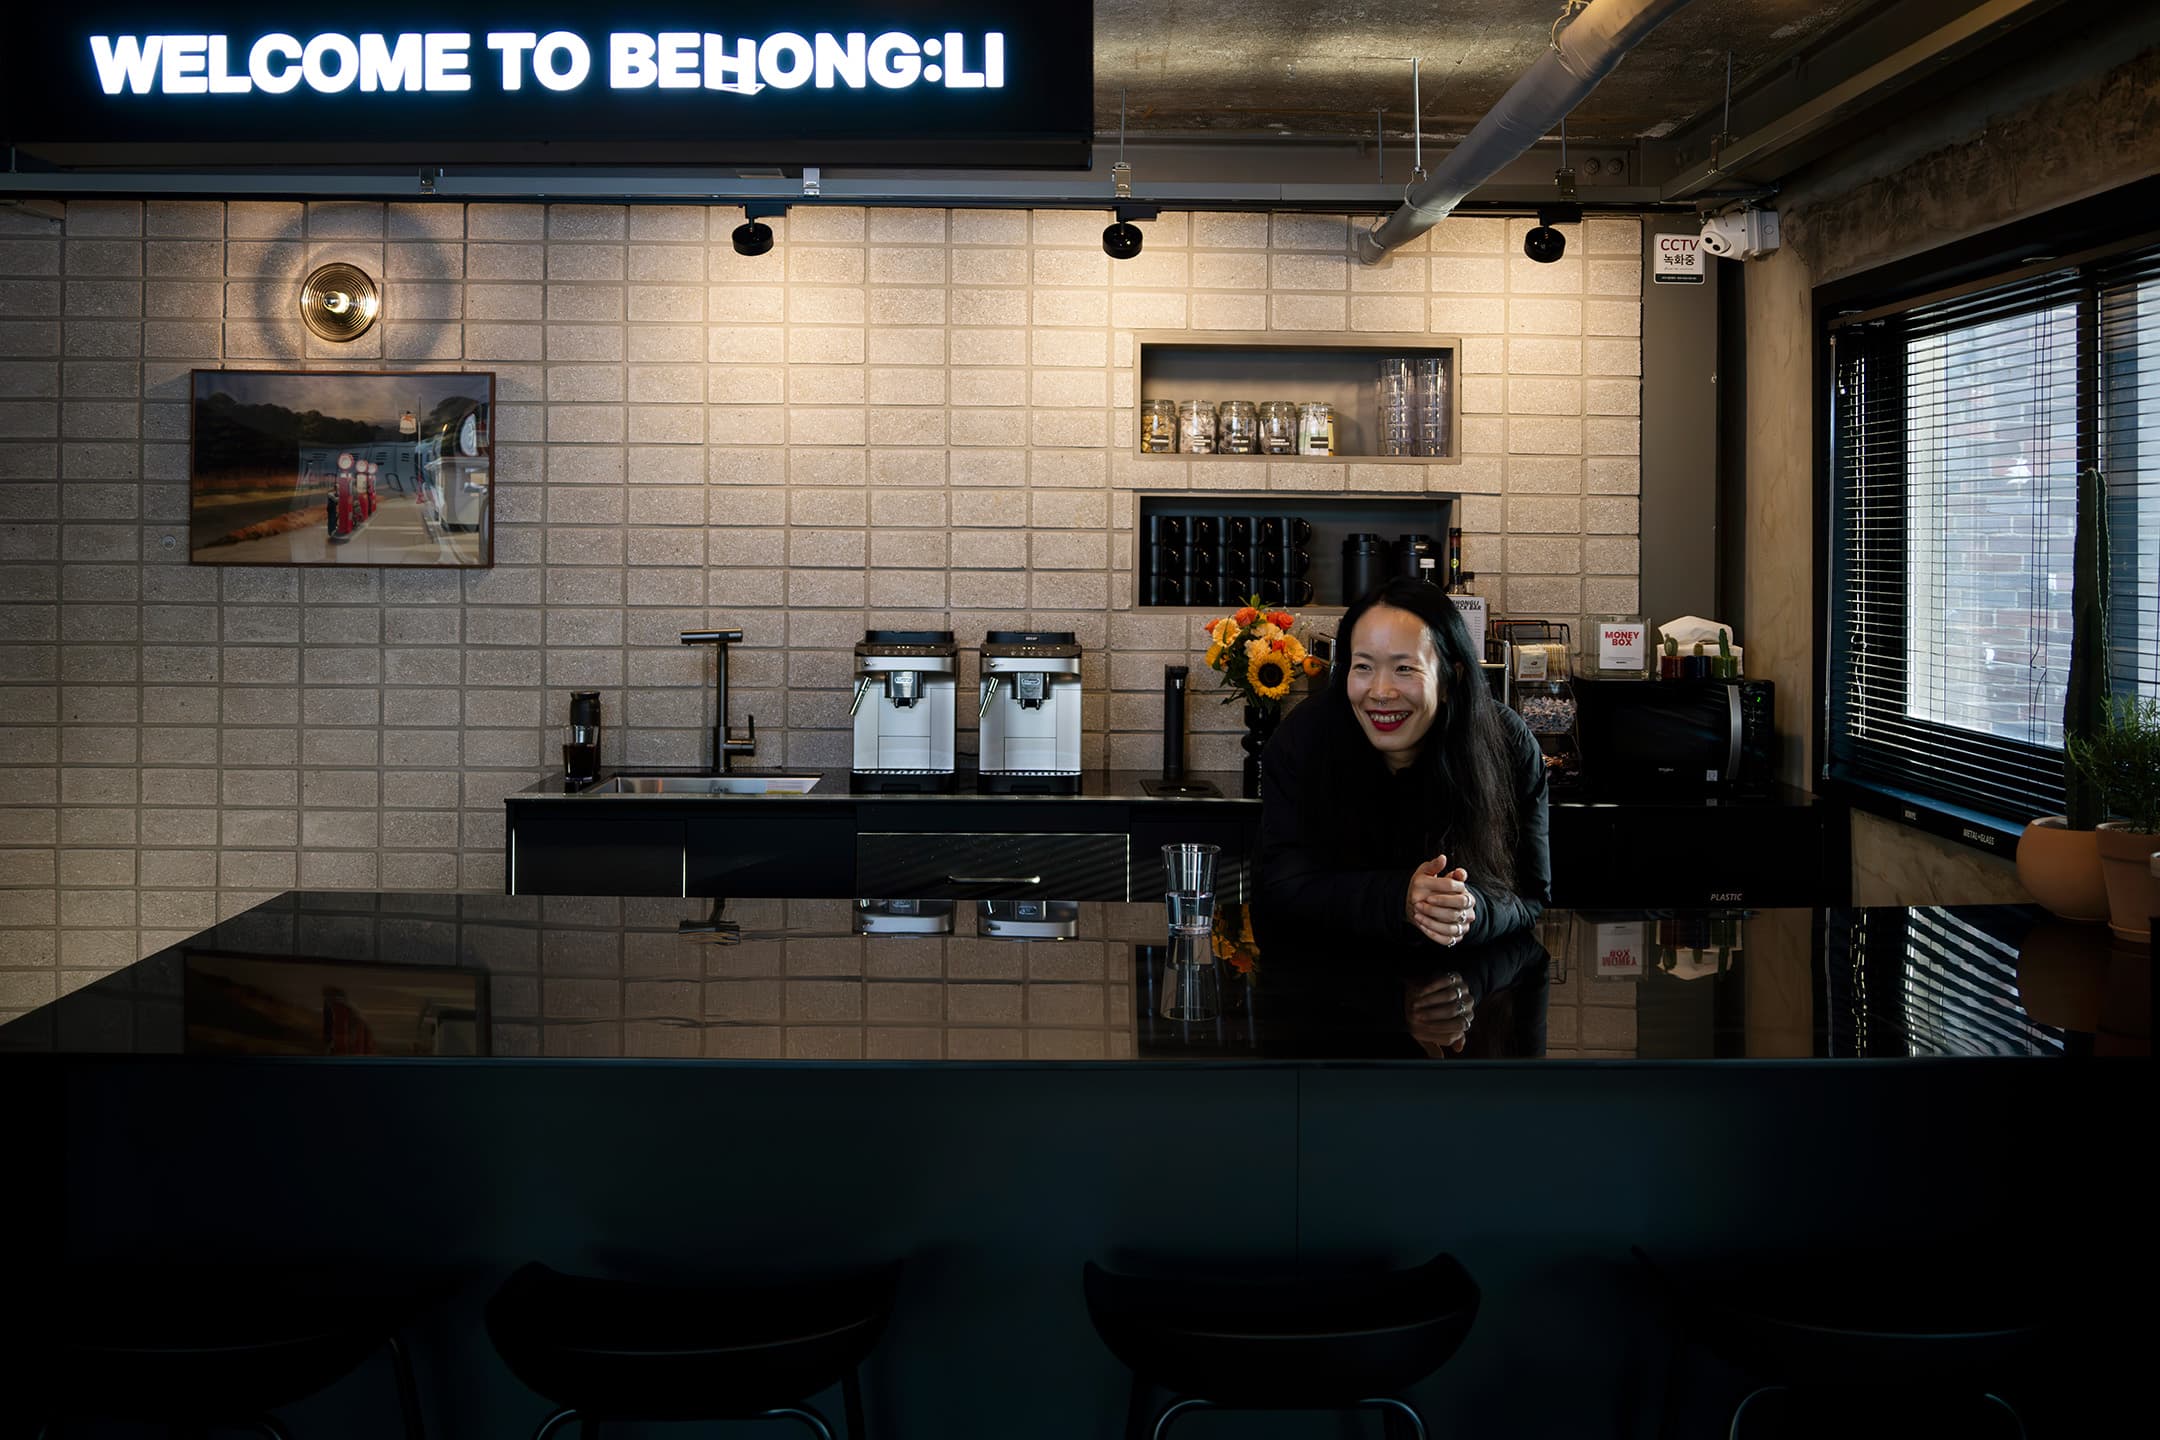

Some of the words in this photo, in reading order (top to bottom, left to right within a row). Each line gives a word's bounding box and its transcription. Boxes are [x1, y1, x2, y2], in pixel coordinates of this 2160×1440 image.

[89, 32, 472, 95] WELCOME
[487, 31, 591, 92] TO
[609, 31, 1005, 96] BEHONG:LI
[1660, 238, 1700, 251] CCTV
[1663, 253, 1696, 266] 녹화중
[1604, 631, 1640, 639] MONEY
[1710, 893, 1743, 901] PLASTIC
